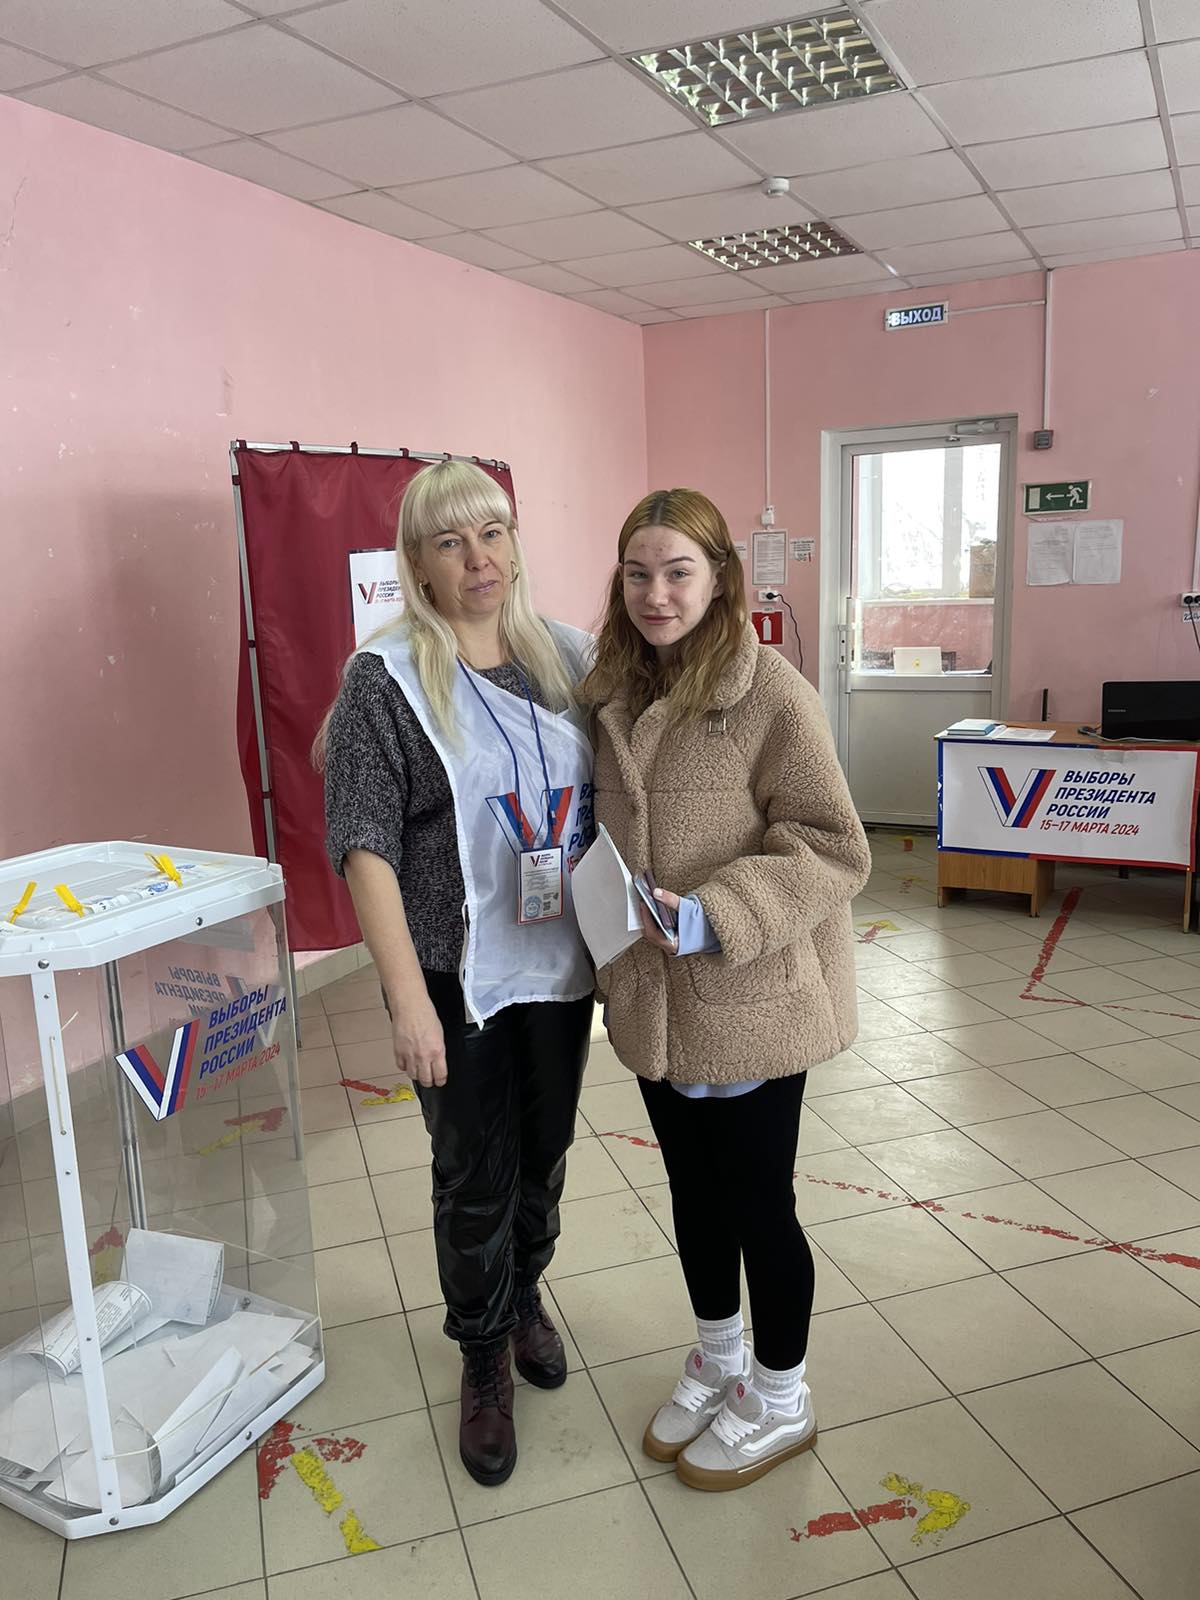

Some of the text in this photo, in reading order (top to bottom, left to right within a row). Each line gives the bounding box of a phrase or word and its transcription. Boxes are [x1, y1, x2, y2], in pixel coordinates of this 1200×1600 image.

[890, 307, 942, 327] ВЫХОД
[1062, 770, 1136, 786] ВЫБОРЫ
[1054, 787, 1156, 805] ПРЕЗИДЕНТА
[1046, 803, 1111, 819] РОССИИ
[1071, 821, 1110, 834] МАРТА
[1111, 823, 1141, 836] 2024
[208, 984, 269, 1029] ВЫБОРЫ
[204, 997, 287, 1055] ПРЕЗИДЕНТА
[199, 1035, 256, 1080] РОССИИ
[225, 1056, 258, 1086] МАРТА
[258, 1041, 281, 1066] 2024
